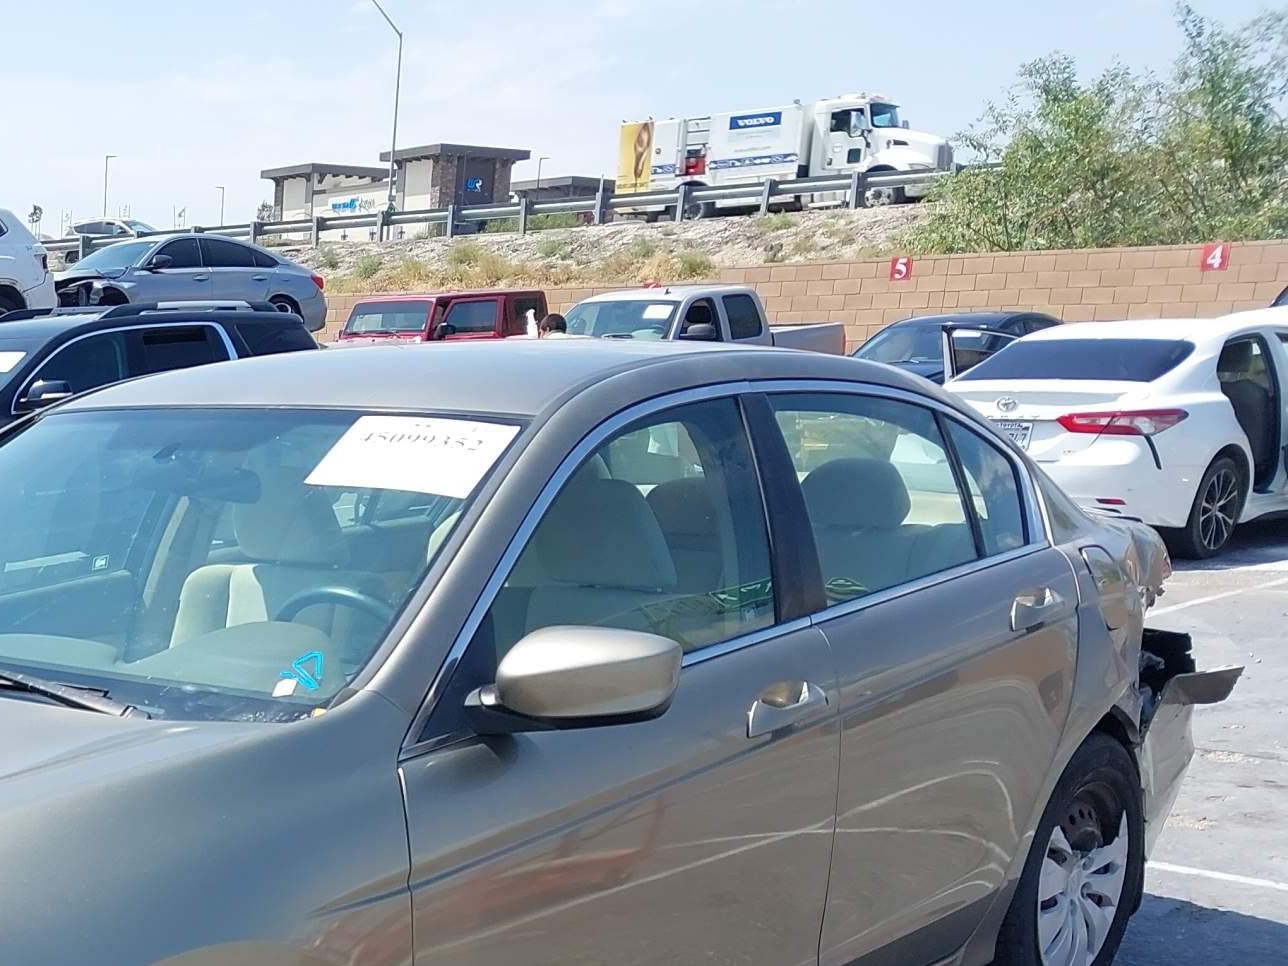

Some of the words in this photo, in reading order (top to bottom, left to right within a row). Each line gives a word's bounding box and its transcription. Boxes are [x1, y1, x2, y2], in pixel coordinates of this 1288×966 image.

[736, 116, 775, 126] VOLVO
[1206, 244, 1223, 268] 4
[894, 257, 908, 279] 5
